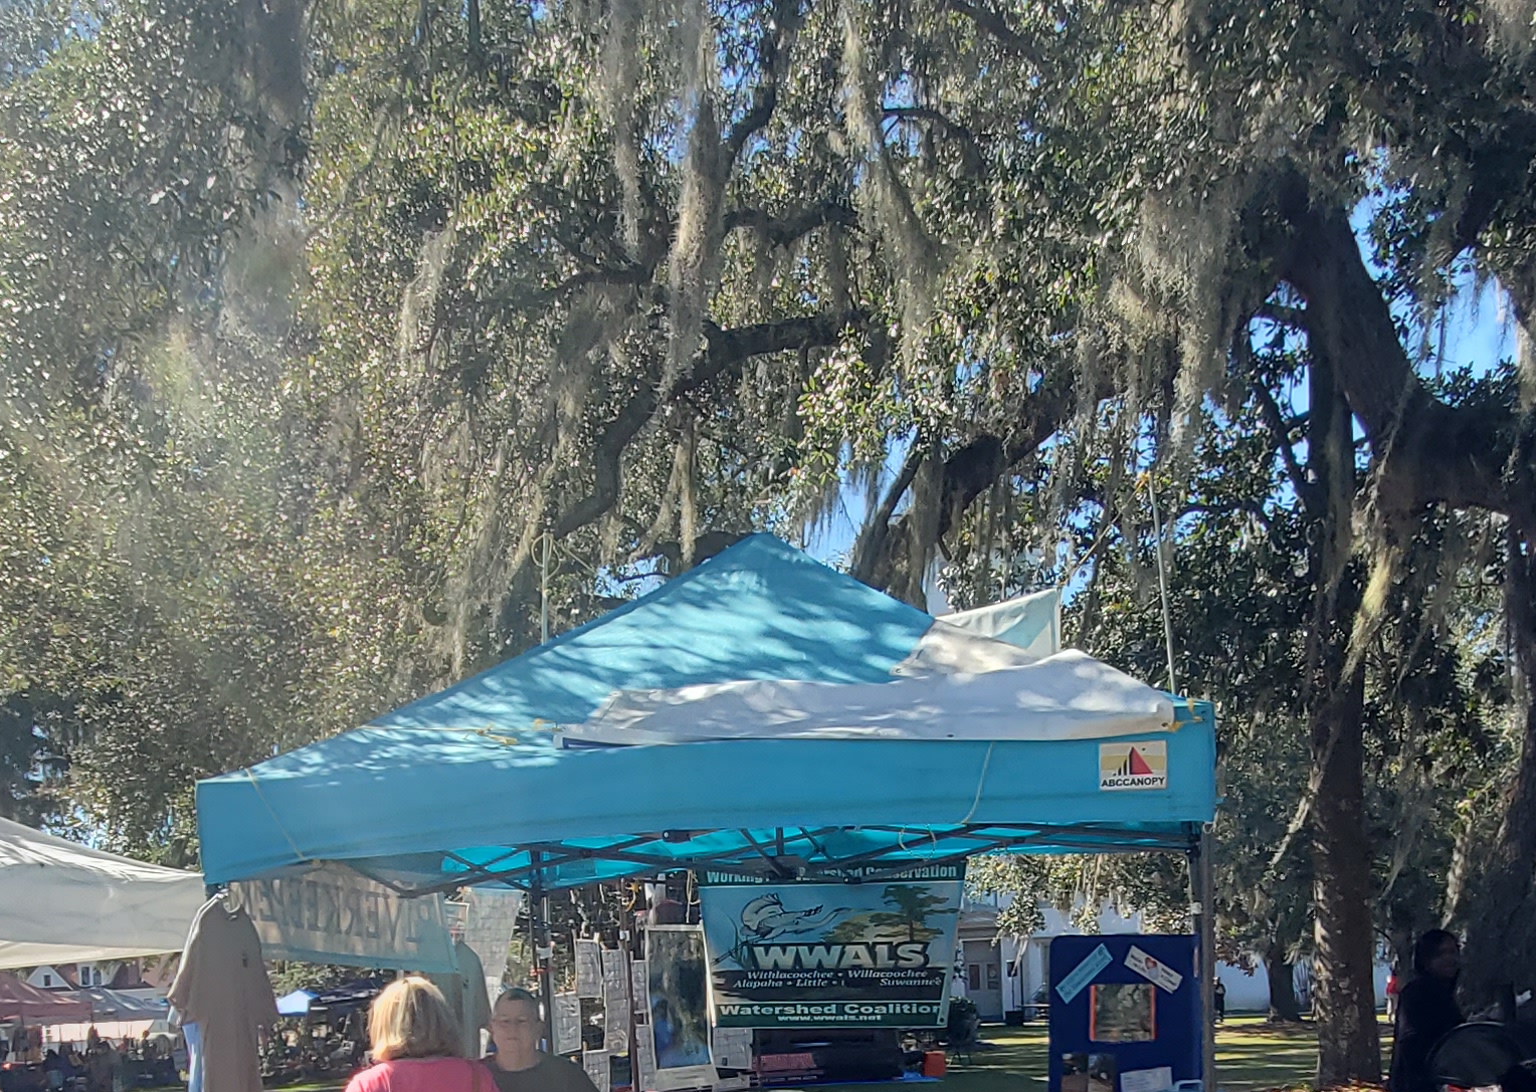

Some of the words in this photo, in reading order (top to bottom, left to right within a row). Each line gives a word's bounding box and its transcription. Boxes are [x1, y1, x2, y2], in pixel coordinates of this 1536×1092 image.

[1101, 776, 1165, 788] ABCCANOPY
[751, 943, 928, 970] WWALS
[747, 969, 834, 980] Withlacoochee
[847, 968, 928, 979] Willacoochee
[732, 978, 783, 989] Alapaha
[795, 978, 828, 987] Little
[720, 1002, 837, 1016] Watershed
